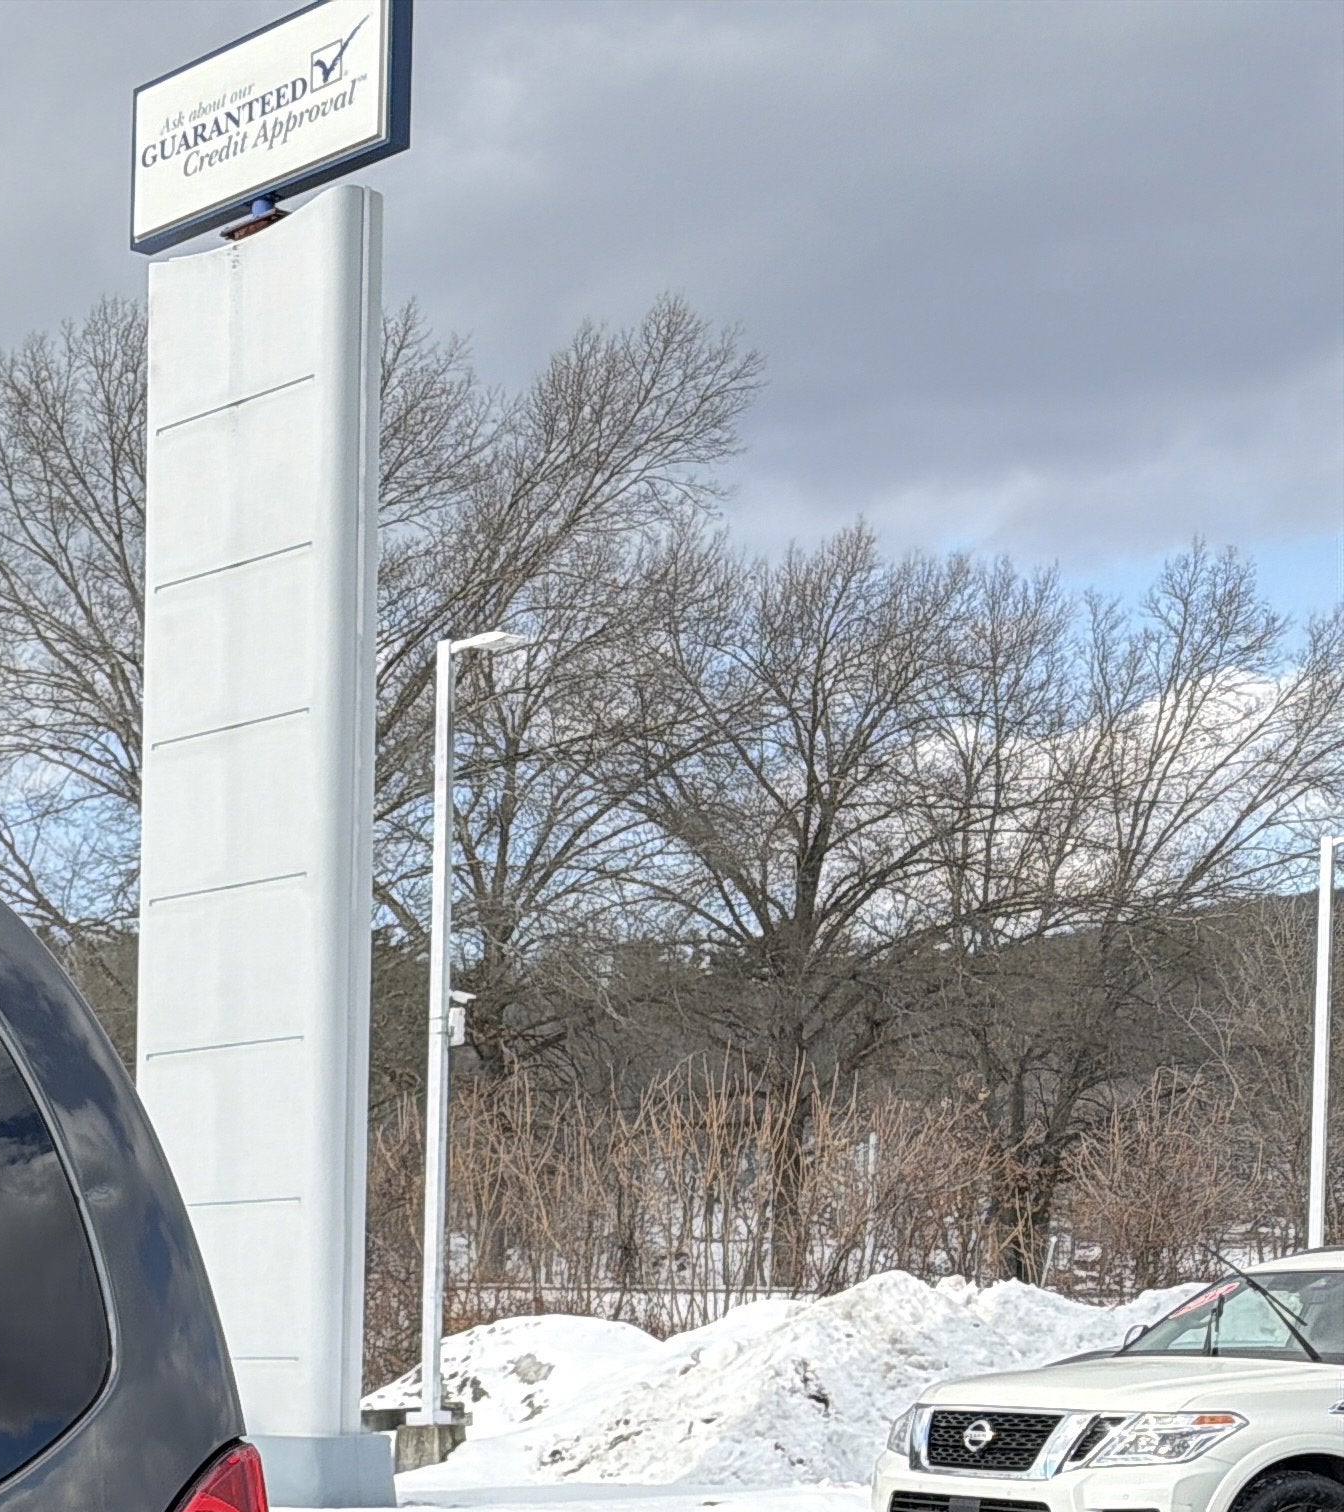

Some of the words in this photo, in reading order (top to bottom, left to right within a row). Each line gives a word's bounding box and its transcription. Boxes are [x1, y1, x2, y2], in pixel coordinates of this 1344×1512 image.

[141, 77, 308, 168] GUARANTEED
[183, 131, 248, 177] Credit
[251, 78, 357, 151] Approval
[189, 93, 227, 122] about
[230, 83, 255, 103] our
